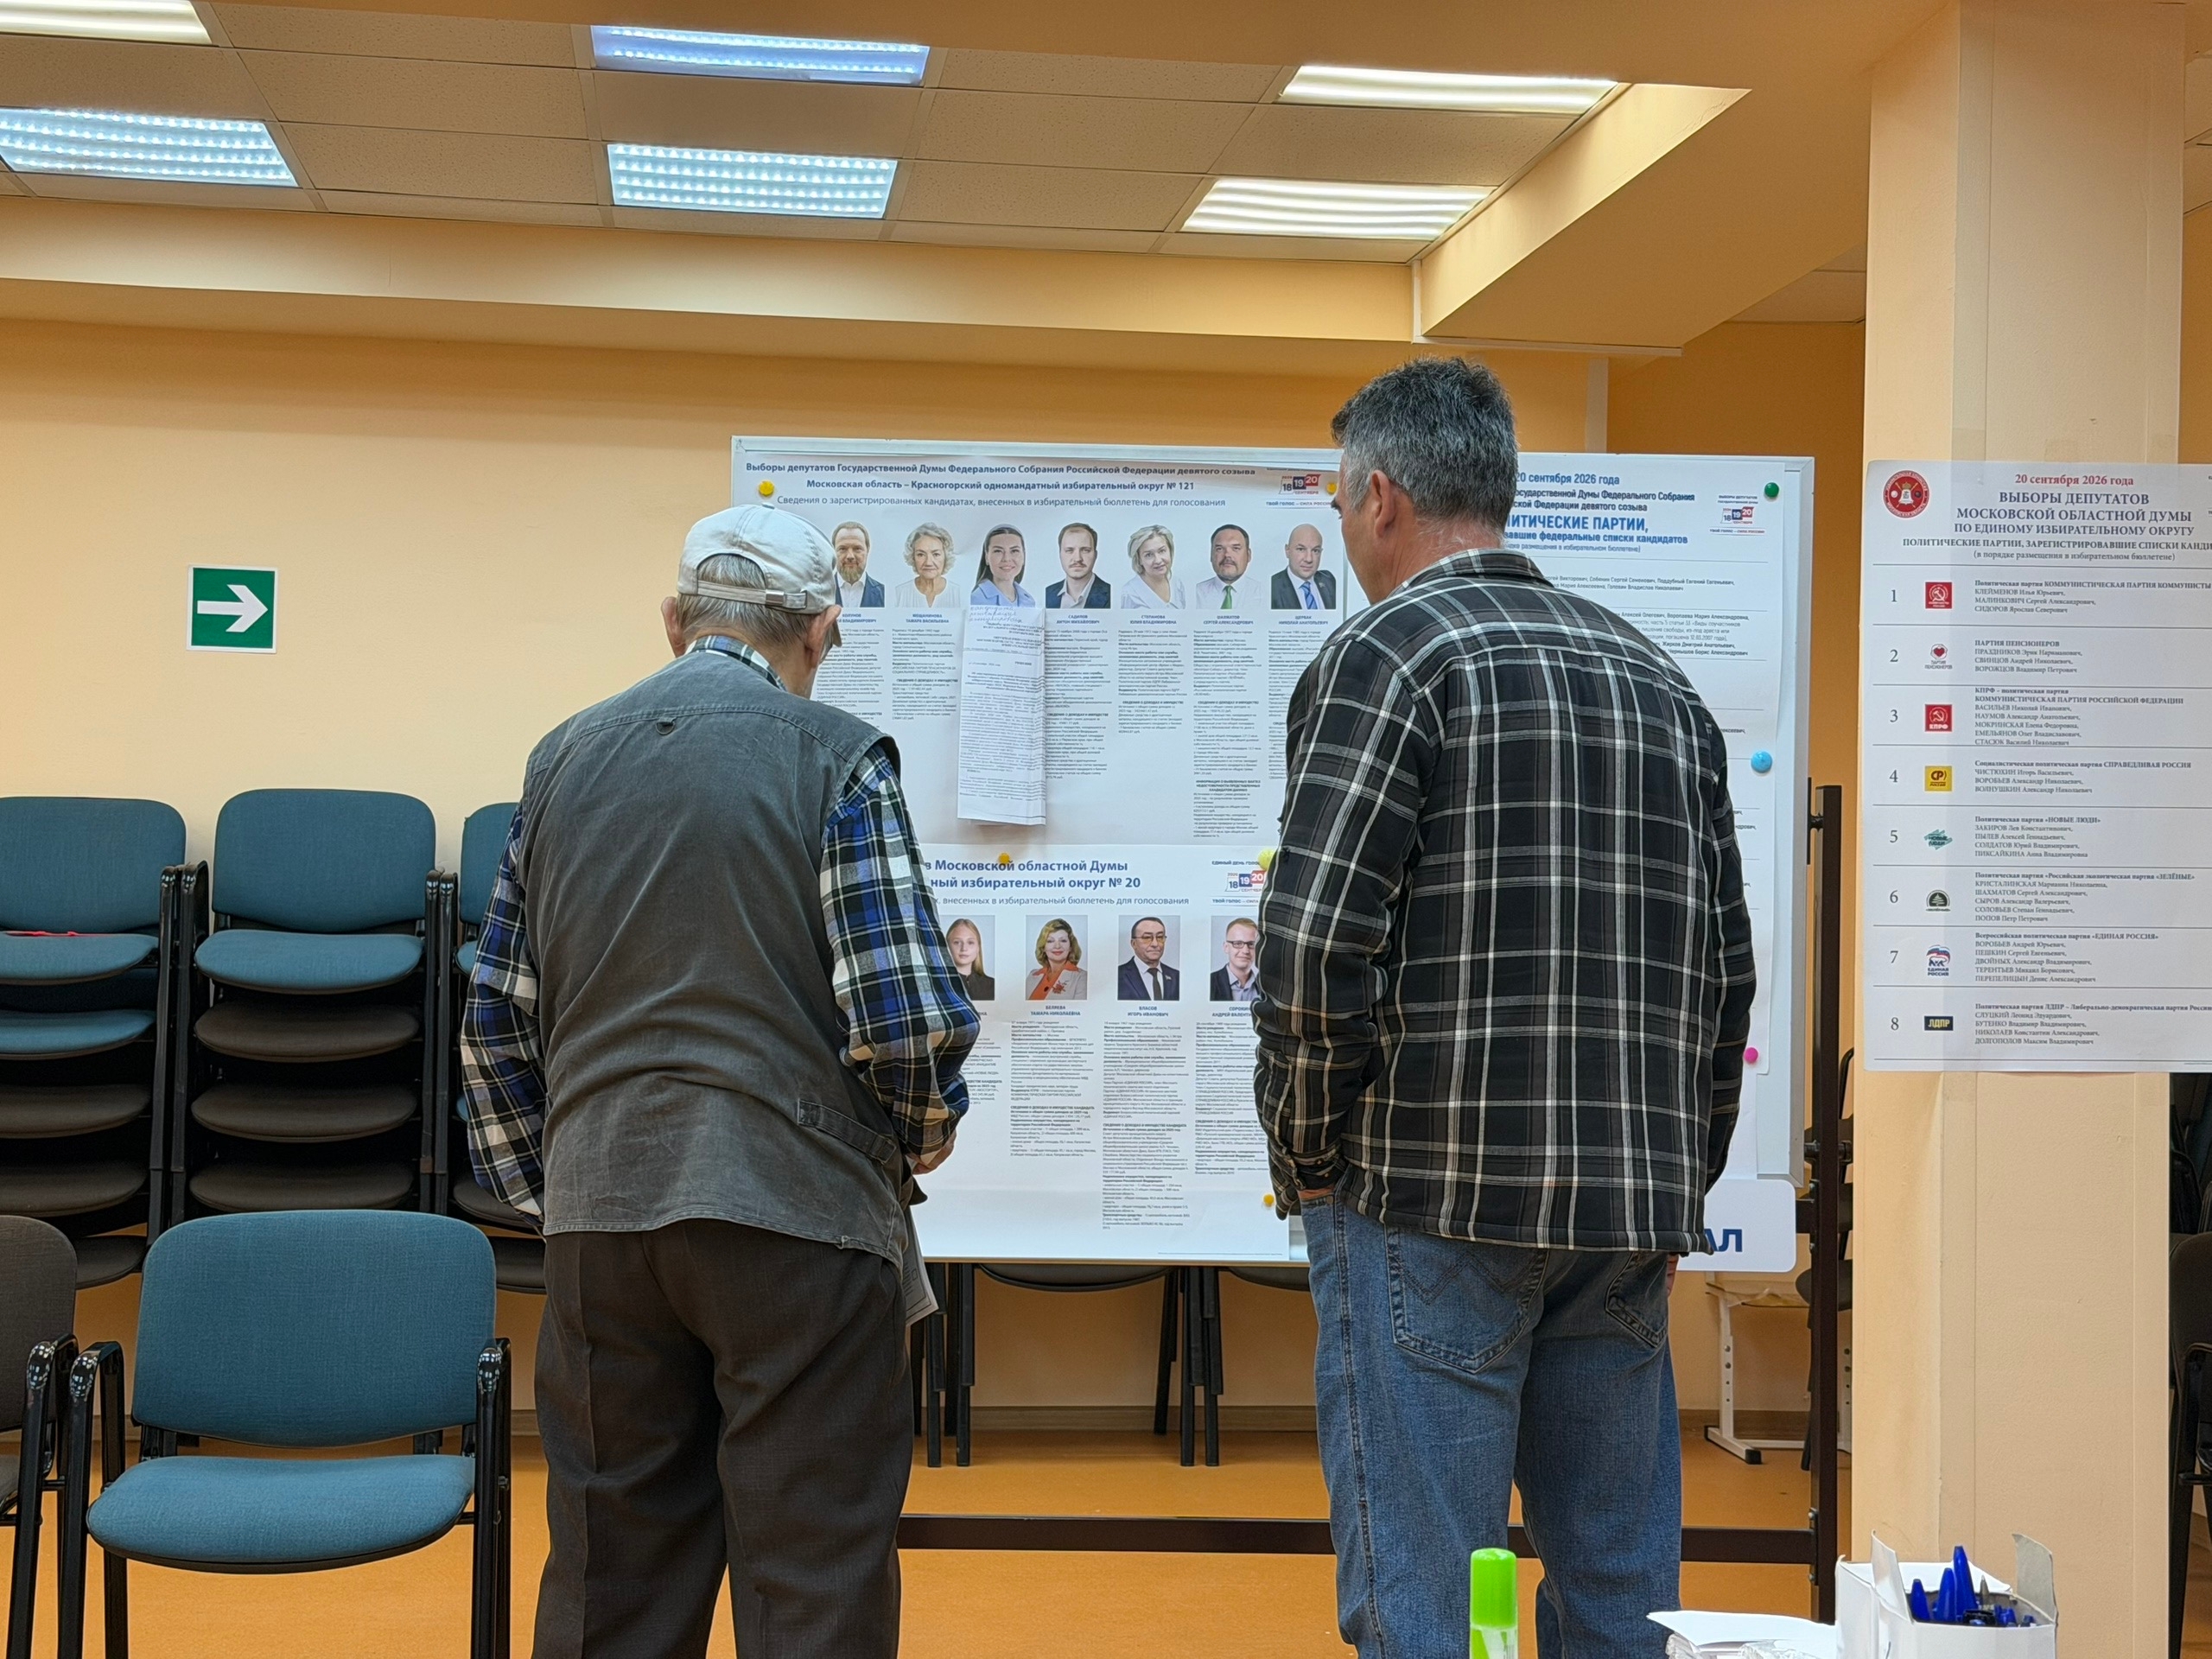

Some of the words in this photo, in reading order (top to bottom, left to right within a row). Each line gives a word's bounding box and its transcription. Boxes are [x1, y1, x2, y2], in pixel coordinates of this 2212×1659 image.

[746, 462, 785, 473] Выборы
[786, 465, 835, 474] депутатов
[836, 463, 917, 474] Государственной
[918, 464, 946, 474] Думы
[947, 464, 1016, 474] Федерального
[1018, 464, 1064, 474] Собрания
[1065, 465, 1120, 474] Российской
[1122, 466, 1175, 475] Федерации
[864, 480, 902, 488] область
[911, 480, 982, 491] Красногорский
[983, 480, 1059, 491] одномандатный
[1062, 480, 1135, 491] избирательный
[1306, 475, 1318, 484] 20
[1528, 472, 1572, 485] сентября
[1573, 473, 1596, 484] 2026
[1598, 476, 1619, 486] года
[2015, 474, 2027, 483] 20
[2029, 474, 2079, 487] сентября
[2082, 474, 2107, 485] 2026
[2110, 477, 2133, 486] года
[777, 495, 819, 505] Сведения
[830, 497, 922, 505] зарегистрированных
[1033, 497, 1101, 507] избирательный
[1103, 497, 1150, 505] бюллетень
[1516, 489, 1576, 499] осударственной
[1577, 489, 1599, 499] Думы
[1600, 489, 1656, 501] Федерального
[1657, 491, 1694, 502] Собрания
[1999, 492, 2062, 503] ВЫБОРЫ
[2064, 493, 2149, 505] ДЕПУТАТОВ
[1533, 499, 1580, 510] Федерации
[1956, 505, 2055, 519] МОСКОВСКОЙ
[2058, 507, 2145, 521] ОБЛАСТНОЙ
[2148, 511, 2191, 523] ДУМЫ
[1507, 515, 1588, 529] ИТИЧЕСКИЕ
[1592, 517, 1648, 532] ПАРТИИ,
[1955, 523, 1972, 532] ПО
[1974, 524, 2033, 534] ЕДИНОМУ
[2036, 524, 2146, 535] ИЗБИРАТЕЛЬНОМУ
[2148, 526, 2194, 536] ОКРУГУ
[1538, 531, 1600, 543] федеральные
[1636, 535, 1688, 544] кандидатов
[1903, 537, 1980, 546] ПОЛИТИЧЕСКИЕ
[1982, 539, 2024, 548] ПАРТИИ,
[2025, 540, 2137, 549] ЗАРЕГИСТРИРОВАВШИЕ
[2138, 541, 2178, 550] СПИСКИ
[1973, 550, 1981, 558] (в
[2016, 552, 2063, 561] размещения
[2070, 551, 2129, 562] избирательном
[2131, 552, 2175, 561] бюллетене)
[1891, 590, 1897, 602] 1
[1891, 650, 1898, 662] 2
[1891, 709, 1897, 722] 3
[1890, 770, 1897, 782] 4
[1890, 830, 1897, 842] 5
[935, 859, 1014, 871] Московской
[1017, 860, 1086, 871] областной
[1089, 860, 1128, 873] Думы
[961, 876, 1065, 890] избирательный
[1068, 880, 1105, 890] округ
[1109, 877, 1122, 887] №
[1125, 877, 1141, 887] 20
[1240, 876, 1249, 885] 19
[1251, 873, 1263, 881] 20
[998, 896, 1065, 906] избирательный
[1067, 895, 1115, 904] бюллетень
[1890, 890, 1898, 903] 6
[1891, 950, 1898, 963] 7
[1891, 1018, 1898, 1030] 8
[1928, 1019, 1950, 1028] ЛДПР
